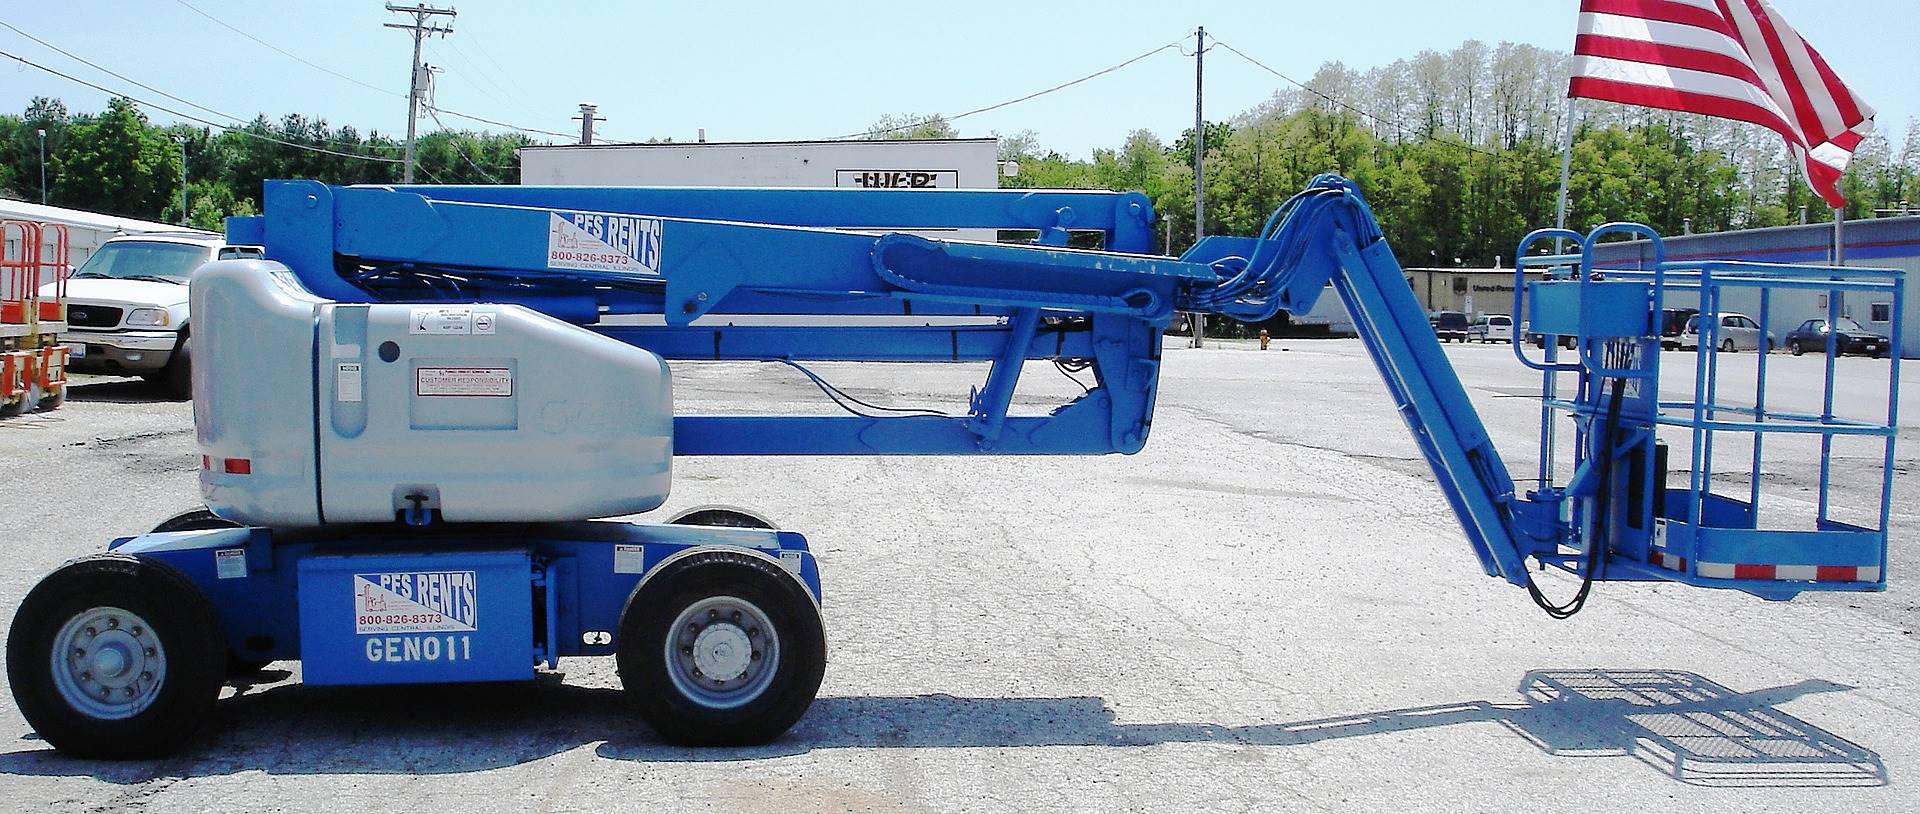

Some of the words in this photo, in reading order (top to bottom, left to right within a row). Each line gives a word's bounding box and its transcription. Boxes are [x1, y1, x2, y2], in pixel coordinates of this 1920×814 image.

[551, 251, 628, 264] 800-826-8373
[574, 214, 604, 240] PFS
[607, 216, 660, 272] RENTS
[380, 574, 412, 600] PFS
[417, 572, 475, 626] RENTS
[359, 614, 442, 625] 800-826-8373
